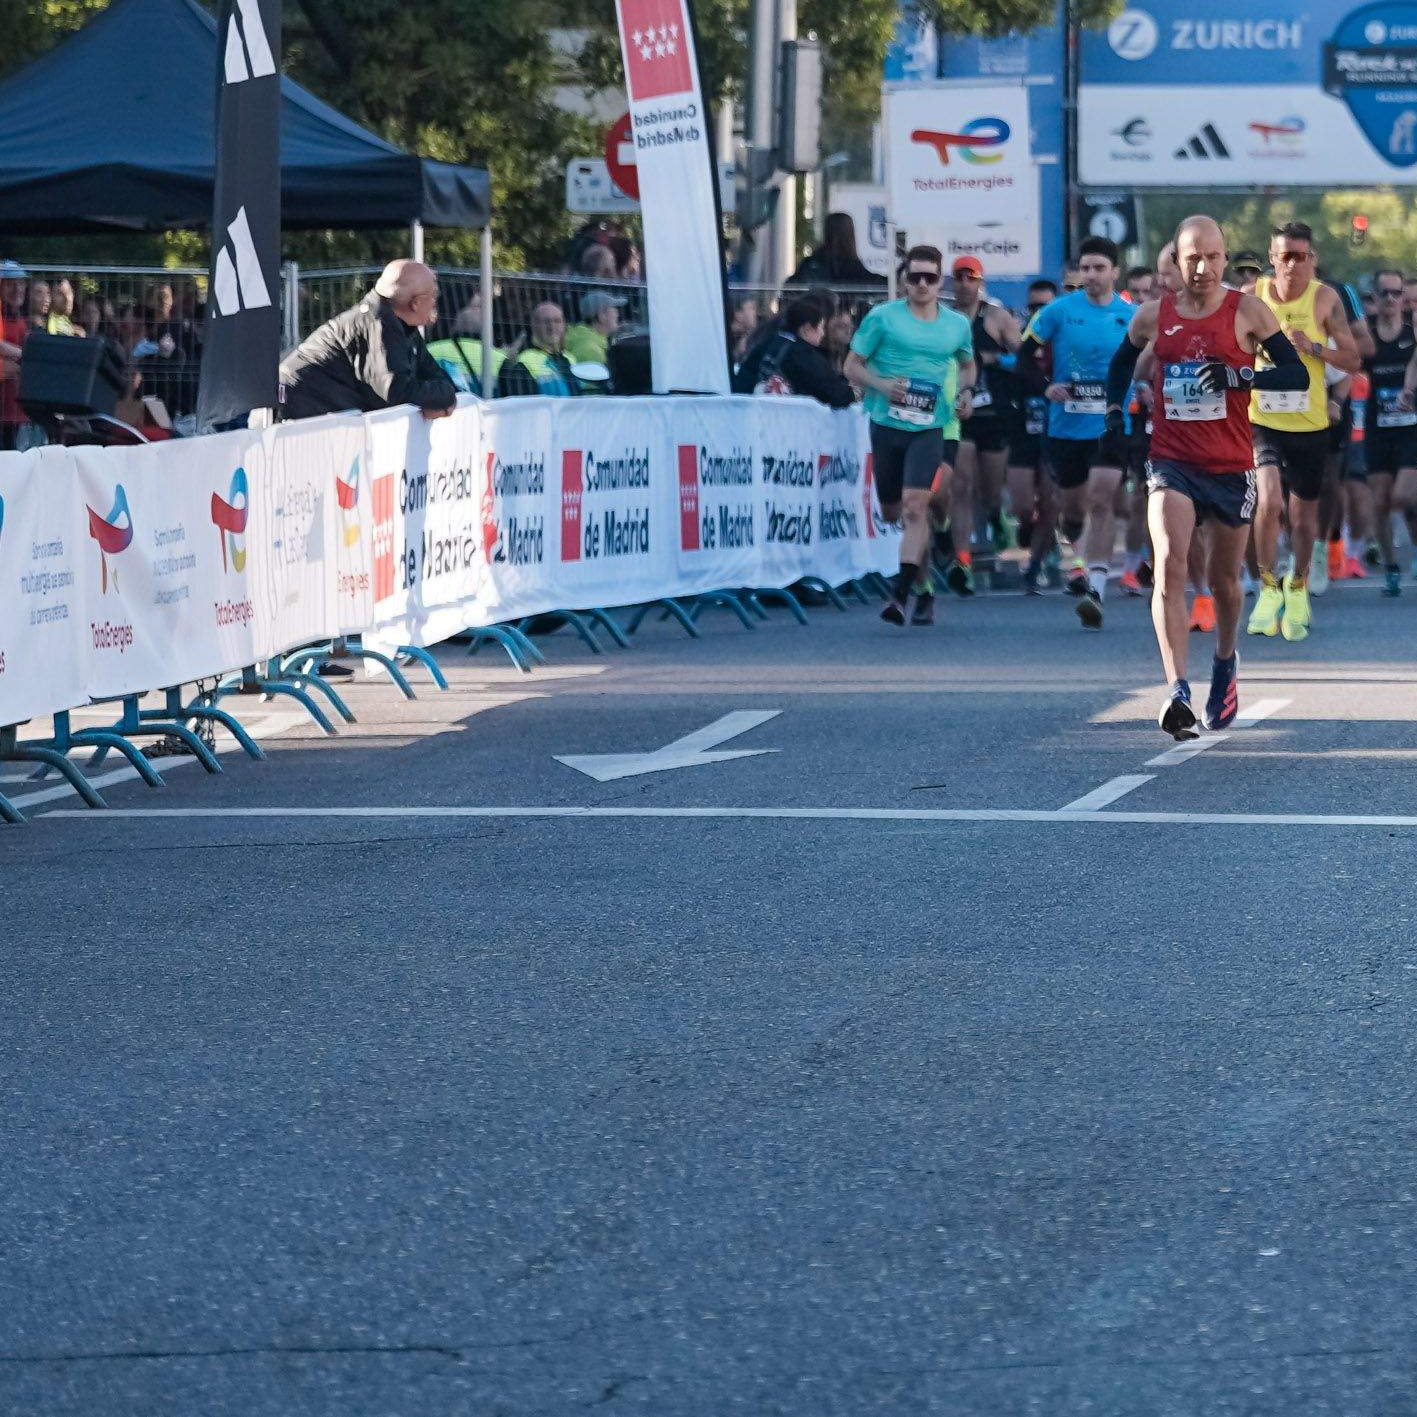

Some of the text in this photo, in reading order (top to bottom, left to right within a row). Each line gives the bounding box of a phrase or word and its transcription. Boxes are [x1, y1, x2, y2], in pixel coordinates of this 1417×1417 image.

[1170, 18, 1301, 50] ZURICH
[912, 175, 1015, 191] TotalEnergies
[586, 447, 649, 491] Comunidad
[508, 515, 544, 565] Madrid
[584, 508, 649, 559] de Madrid
[214, 595, 256, 628] TotalEnergies
[90, 619, 133, 653] TotalEnergies
